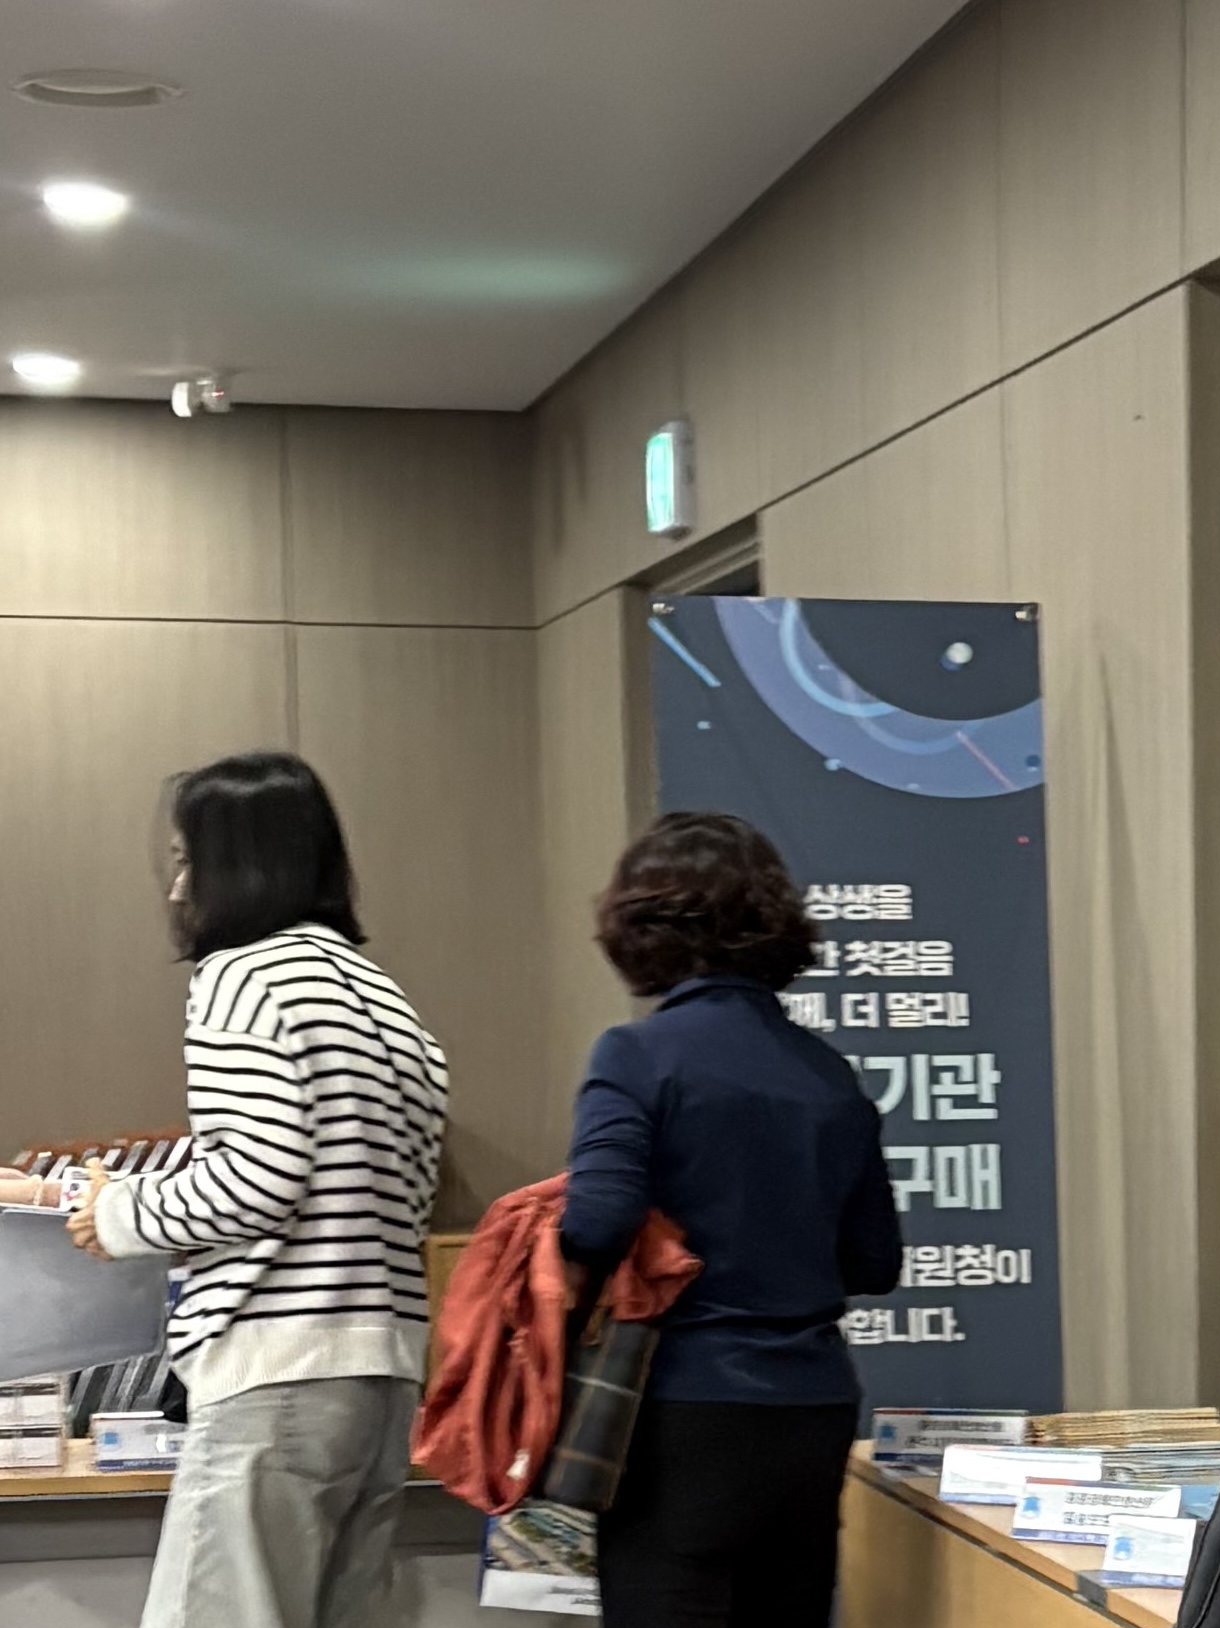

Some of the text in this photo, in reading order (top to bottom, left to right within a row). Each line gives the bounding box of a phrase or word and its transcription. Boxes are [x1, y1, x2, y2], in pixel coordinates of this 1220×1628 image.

[804, 884, 913, 920] 상생을
[845, 940, 954, 977] 첫걸음
[777, 992, 836, 1032] 께,
[841, 993, 879, 1028] 더
[855, 1053, 1001, 1120] 기관
[840, 1306, 966, 1346] 합니다.
